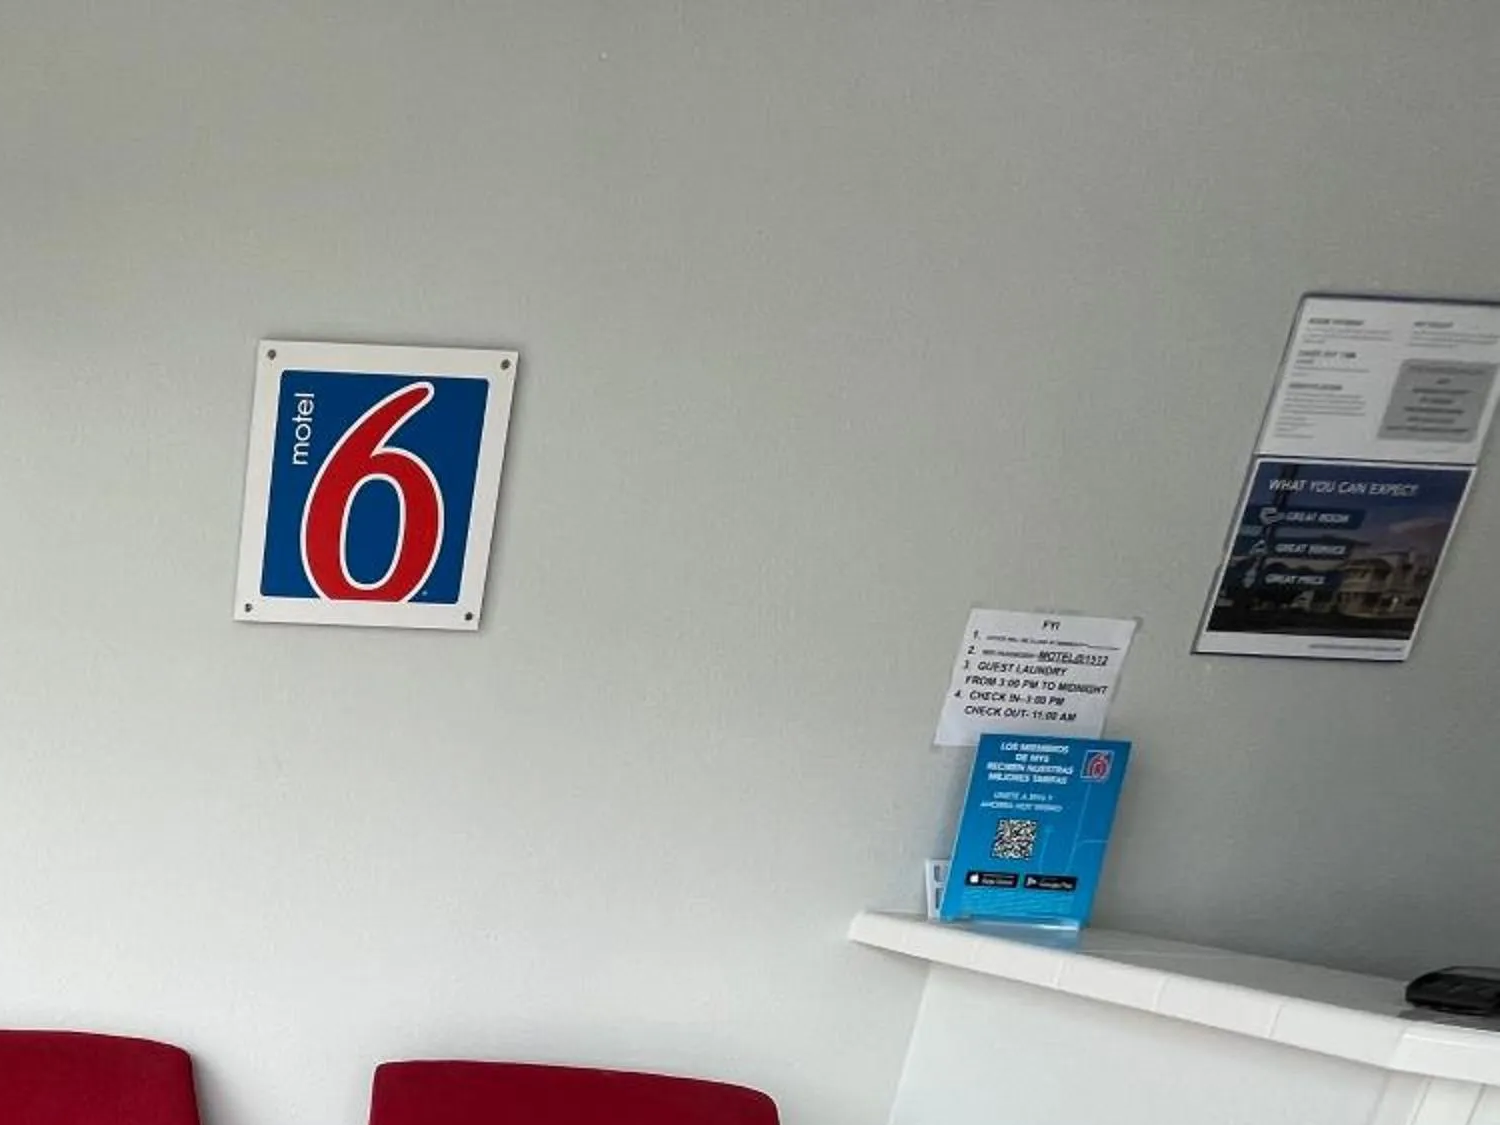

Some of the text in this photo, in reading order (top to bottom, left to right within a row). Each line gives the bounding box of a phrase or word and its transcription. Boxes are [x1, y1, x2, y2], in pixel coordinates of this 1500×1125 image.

[292, 381, 444, 604] motel 6
[1269, 479, 1419, 498] WHAT YOU CAN EXPECT
[977, 661, 1014, 673] GUEST
[1016, 663, 1068, 676] LAUNDRY
[965, 675, 997, 687] FROM
[1021, 679, 1039, 690] PM
[1041, 681, 1056, 691] TO
[1057, 682, 1108, 695] MIDNIGHT
[969, 690, 1006, 702] CHECK
[1048, 696, 1065, 706] PM
[963, 705, 1003, 717] CHECK
[1059, 711, 1077, 722] AM
